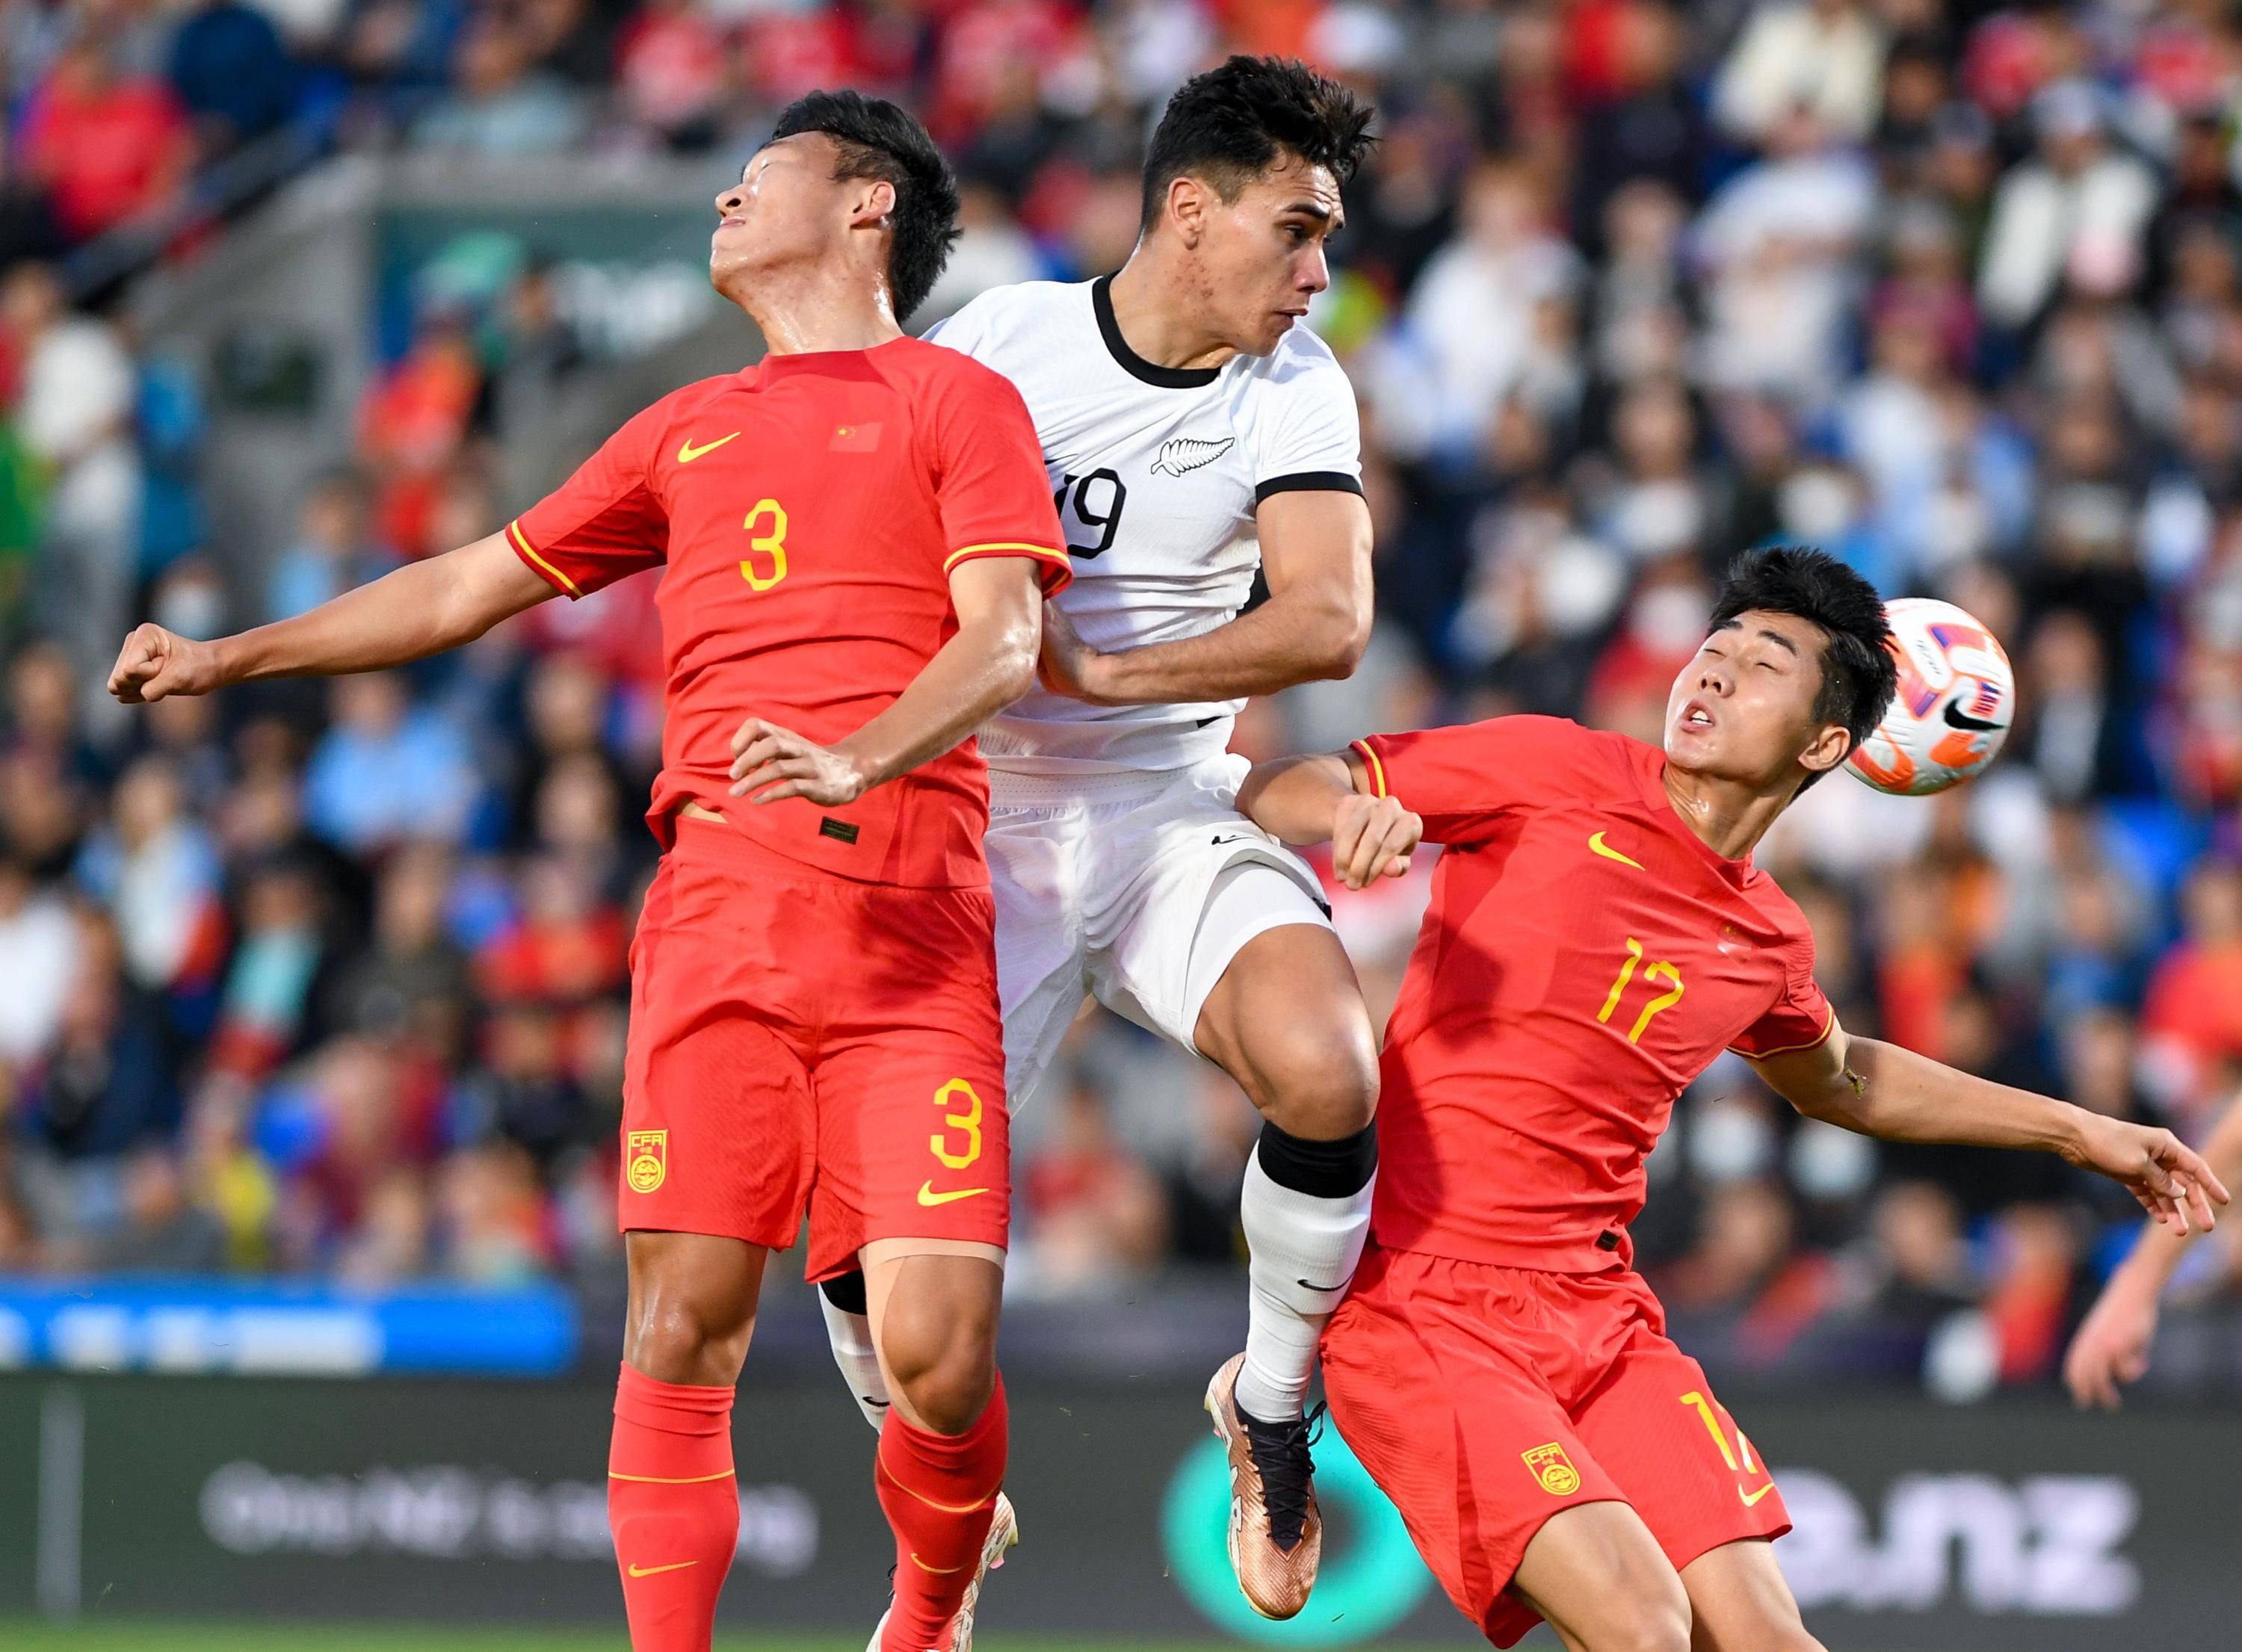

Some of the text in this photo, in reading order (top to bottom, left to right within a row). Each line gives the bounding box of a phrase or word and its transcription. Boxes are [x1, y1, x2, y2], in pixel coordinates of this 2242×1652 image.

[739, 498, 788, 592] 3
[1596, 937, 1685, 1044] 17
[631, 1134, 662, 1148] CFA
[930, 1077, 983, 1169] 3
[1527, 1447, 1561, 1464] CFA
